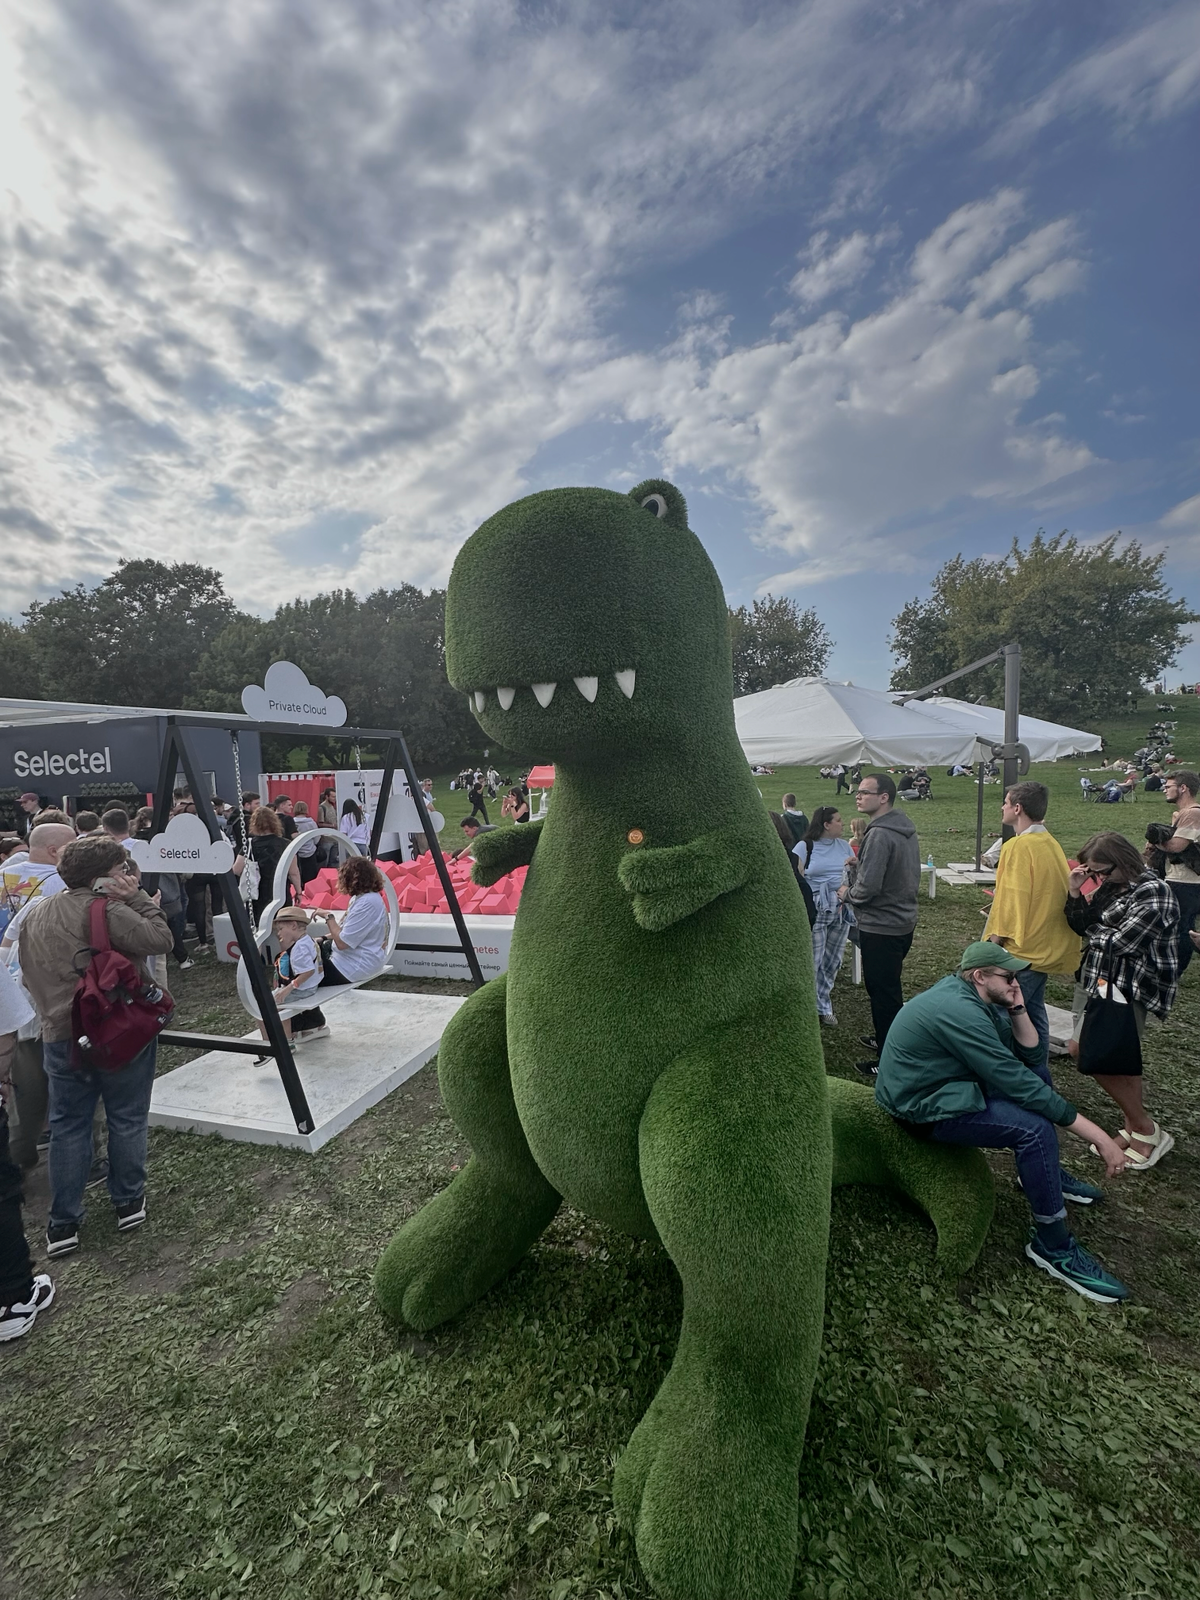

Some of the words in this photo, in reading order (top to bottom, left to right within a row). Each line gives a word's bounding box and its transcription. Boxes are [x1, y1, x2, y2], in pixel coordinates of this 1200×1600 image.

[269, 700, 301, 713] Private
[303, 703, 327, 715] Cloud
[14, 747, 111, 777] Selectel
[160, 848, 200, 859] Selectel
